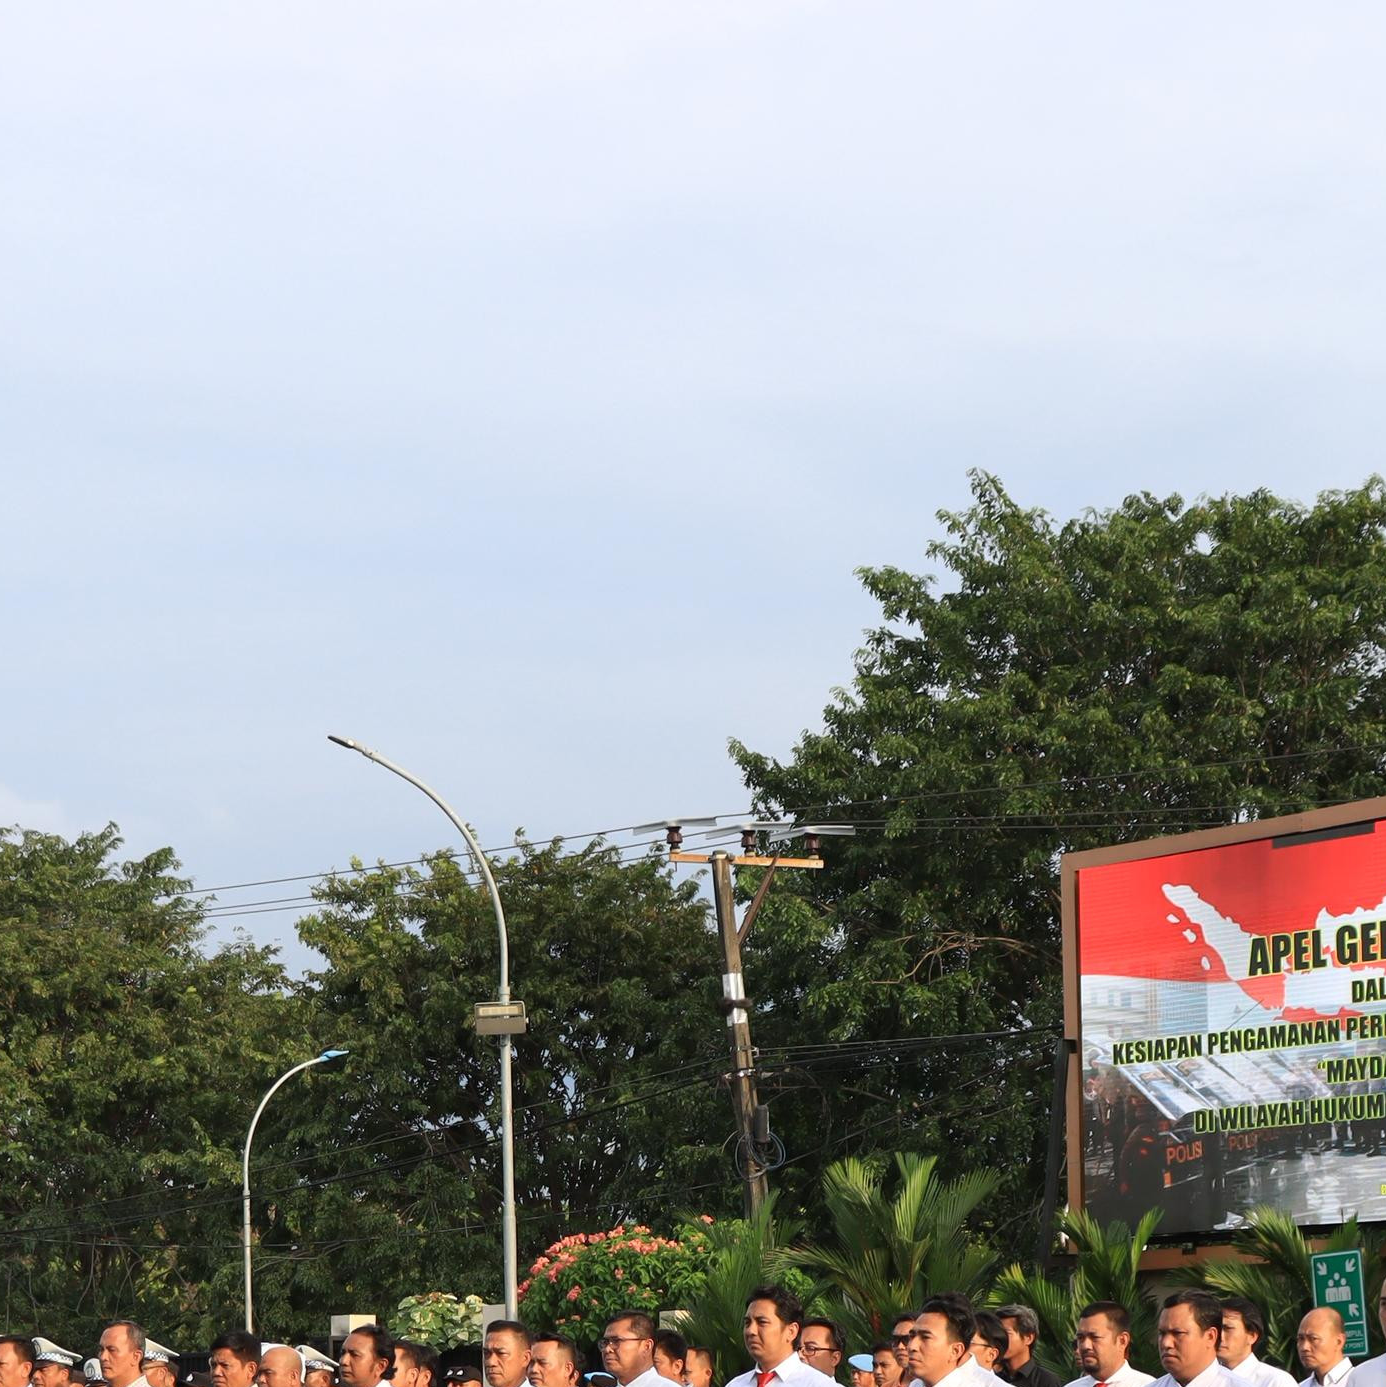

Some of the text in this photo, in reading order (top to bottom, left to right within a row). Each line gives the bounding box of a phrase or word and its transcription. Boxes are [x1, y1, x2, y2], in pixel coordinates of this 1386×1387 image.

[1248, 927, 1327, 977] APEL
[1112, 1032, 1203, 1066] KESIAPAN
[1207, 1018, 1341, 1057] PENGAMANAN
[1193, 1109, 1216, 1135] DI
[1217, 1101, 1311, 1133] WILAYAH
